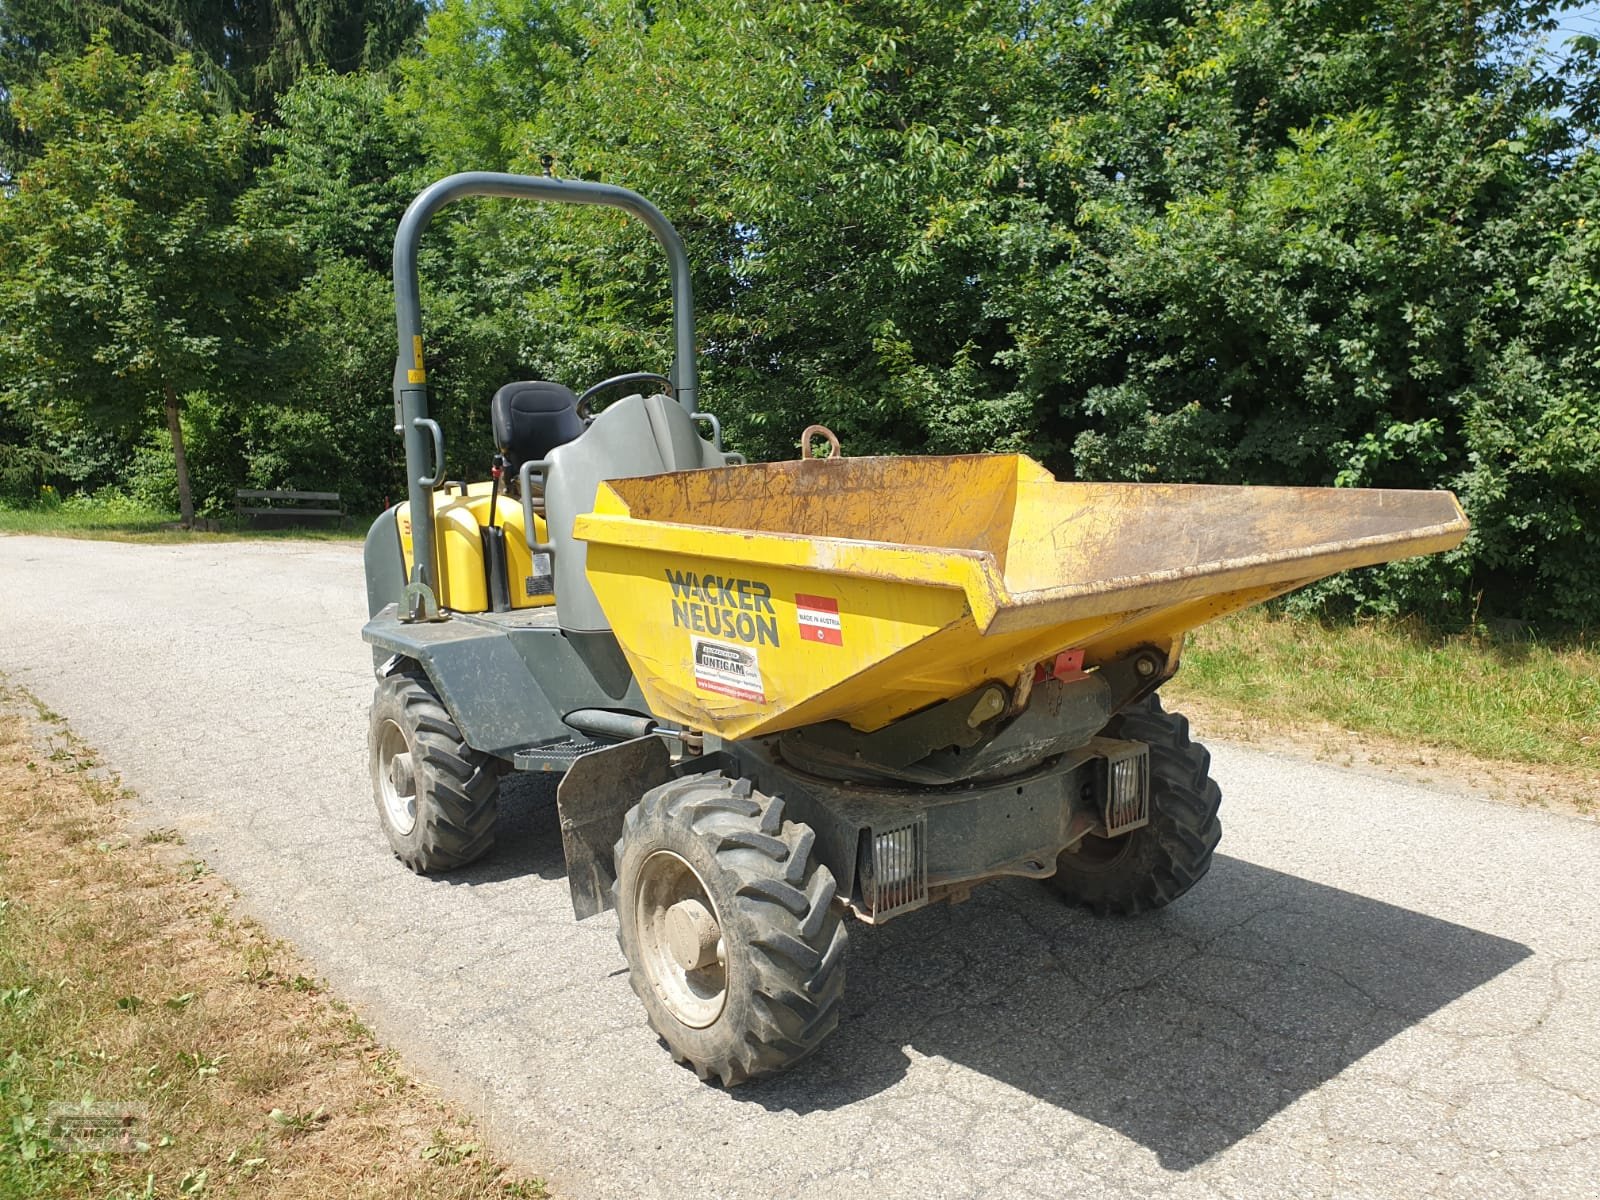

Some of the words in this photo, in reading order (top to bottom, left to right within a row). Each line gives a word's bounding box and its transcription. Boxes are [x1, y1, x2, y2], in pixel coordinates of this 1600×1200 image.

[664, 568, 776, 614] WACKER
[671, 598, 780, 648] NEUSON
[799, 614, 813, 622] MADE
[820, 617, 840, 625] AUSTRIA
